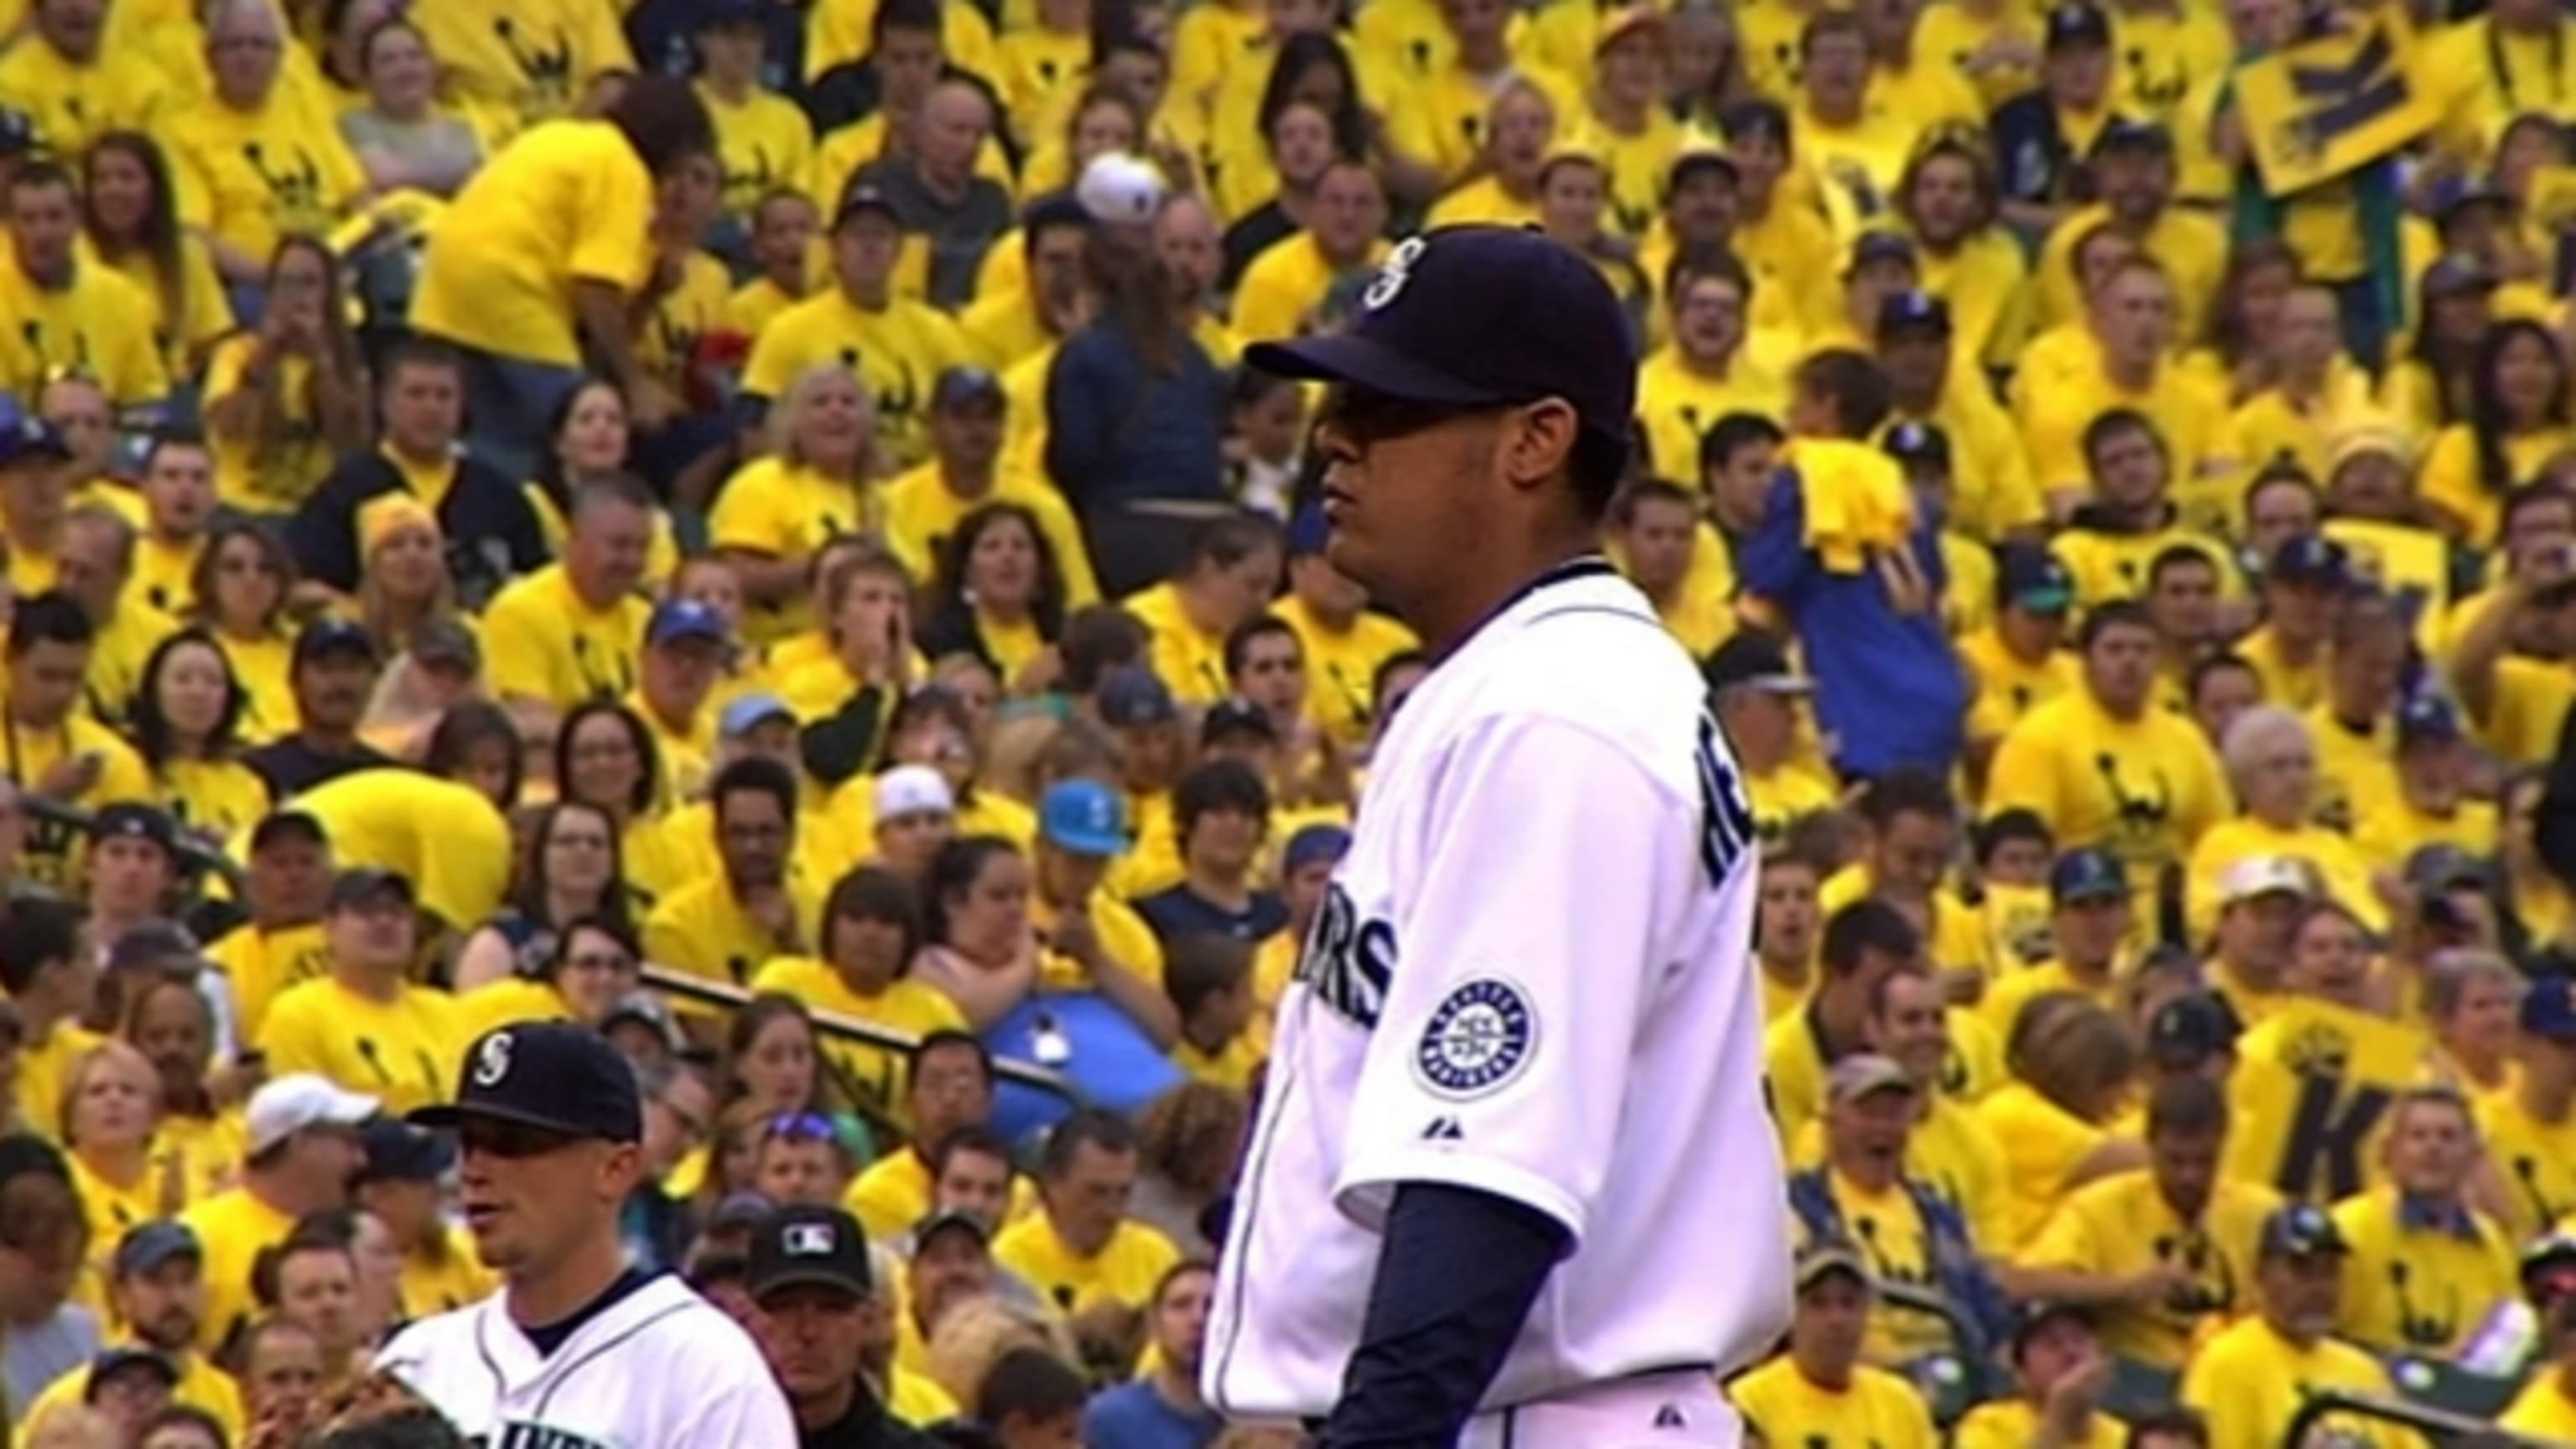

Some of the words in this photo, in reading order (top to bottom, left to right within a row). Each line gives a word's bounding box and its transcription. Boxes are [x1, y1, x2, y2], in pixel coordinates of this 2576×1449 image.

[1363, 236, 1426, 309] S
[474, 1032, 514, 1087] S
[2273, 1070, 2392, 1202] K
